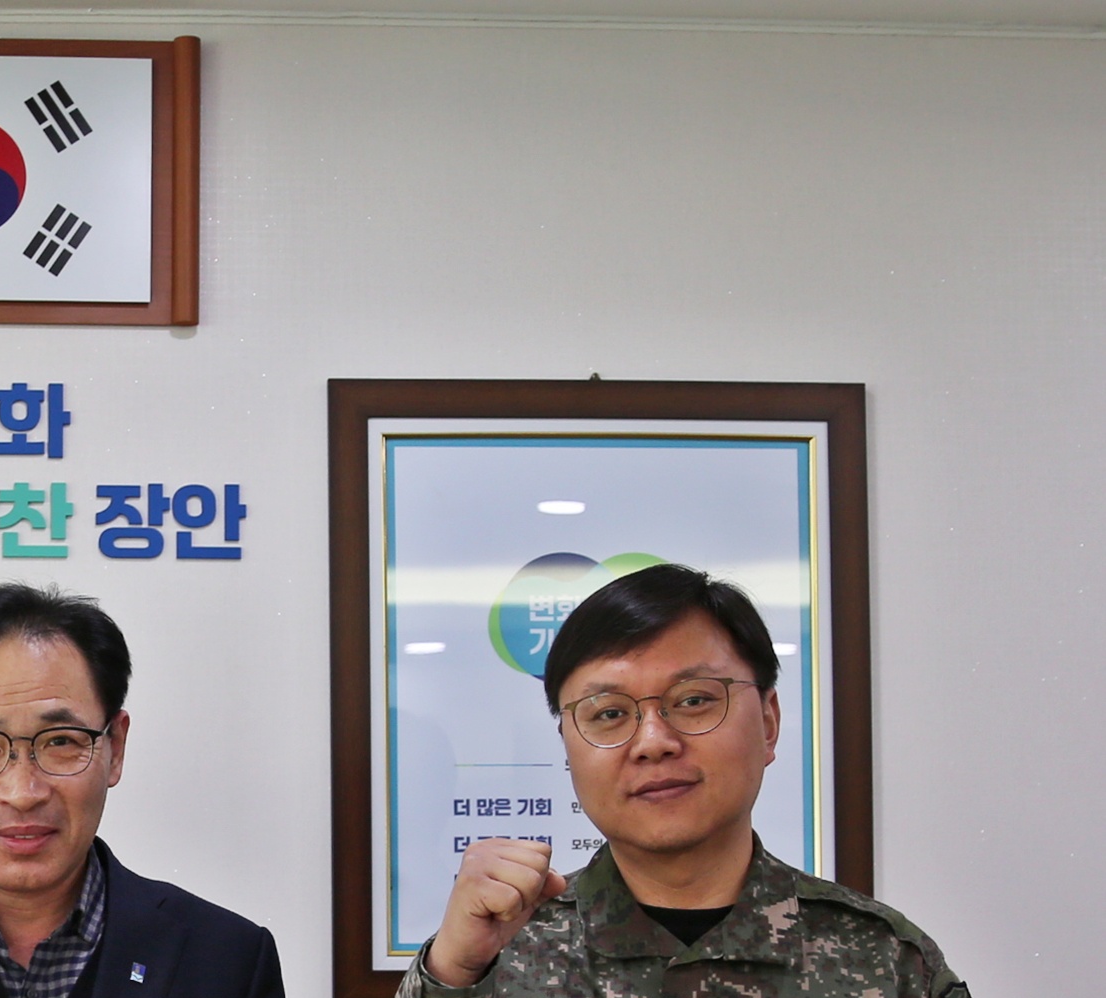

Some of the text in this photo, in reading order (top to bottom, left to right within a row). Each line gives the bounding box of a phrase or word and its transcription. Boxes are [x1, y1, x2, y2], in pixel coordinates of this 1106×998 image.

[94, 483, 247, 560] 장안
[453, 798, 552, 816] 더 많은 기회
